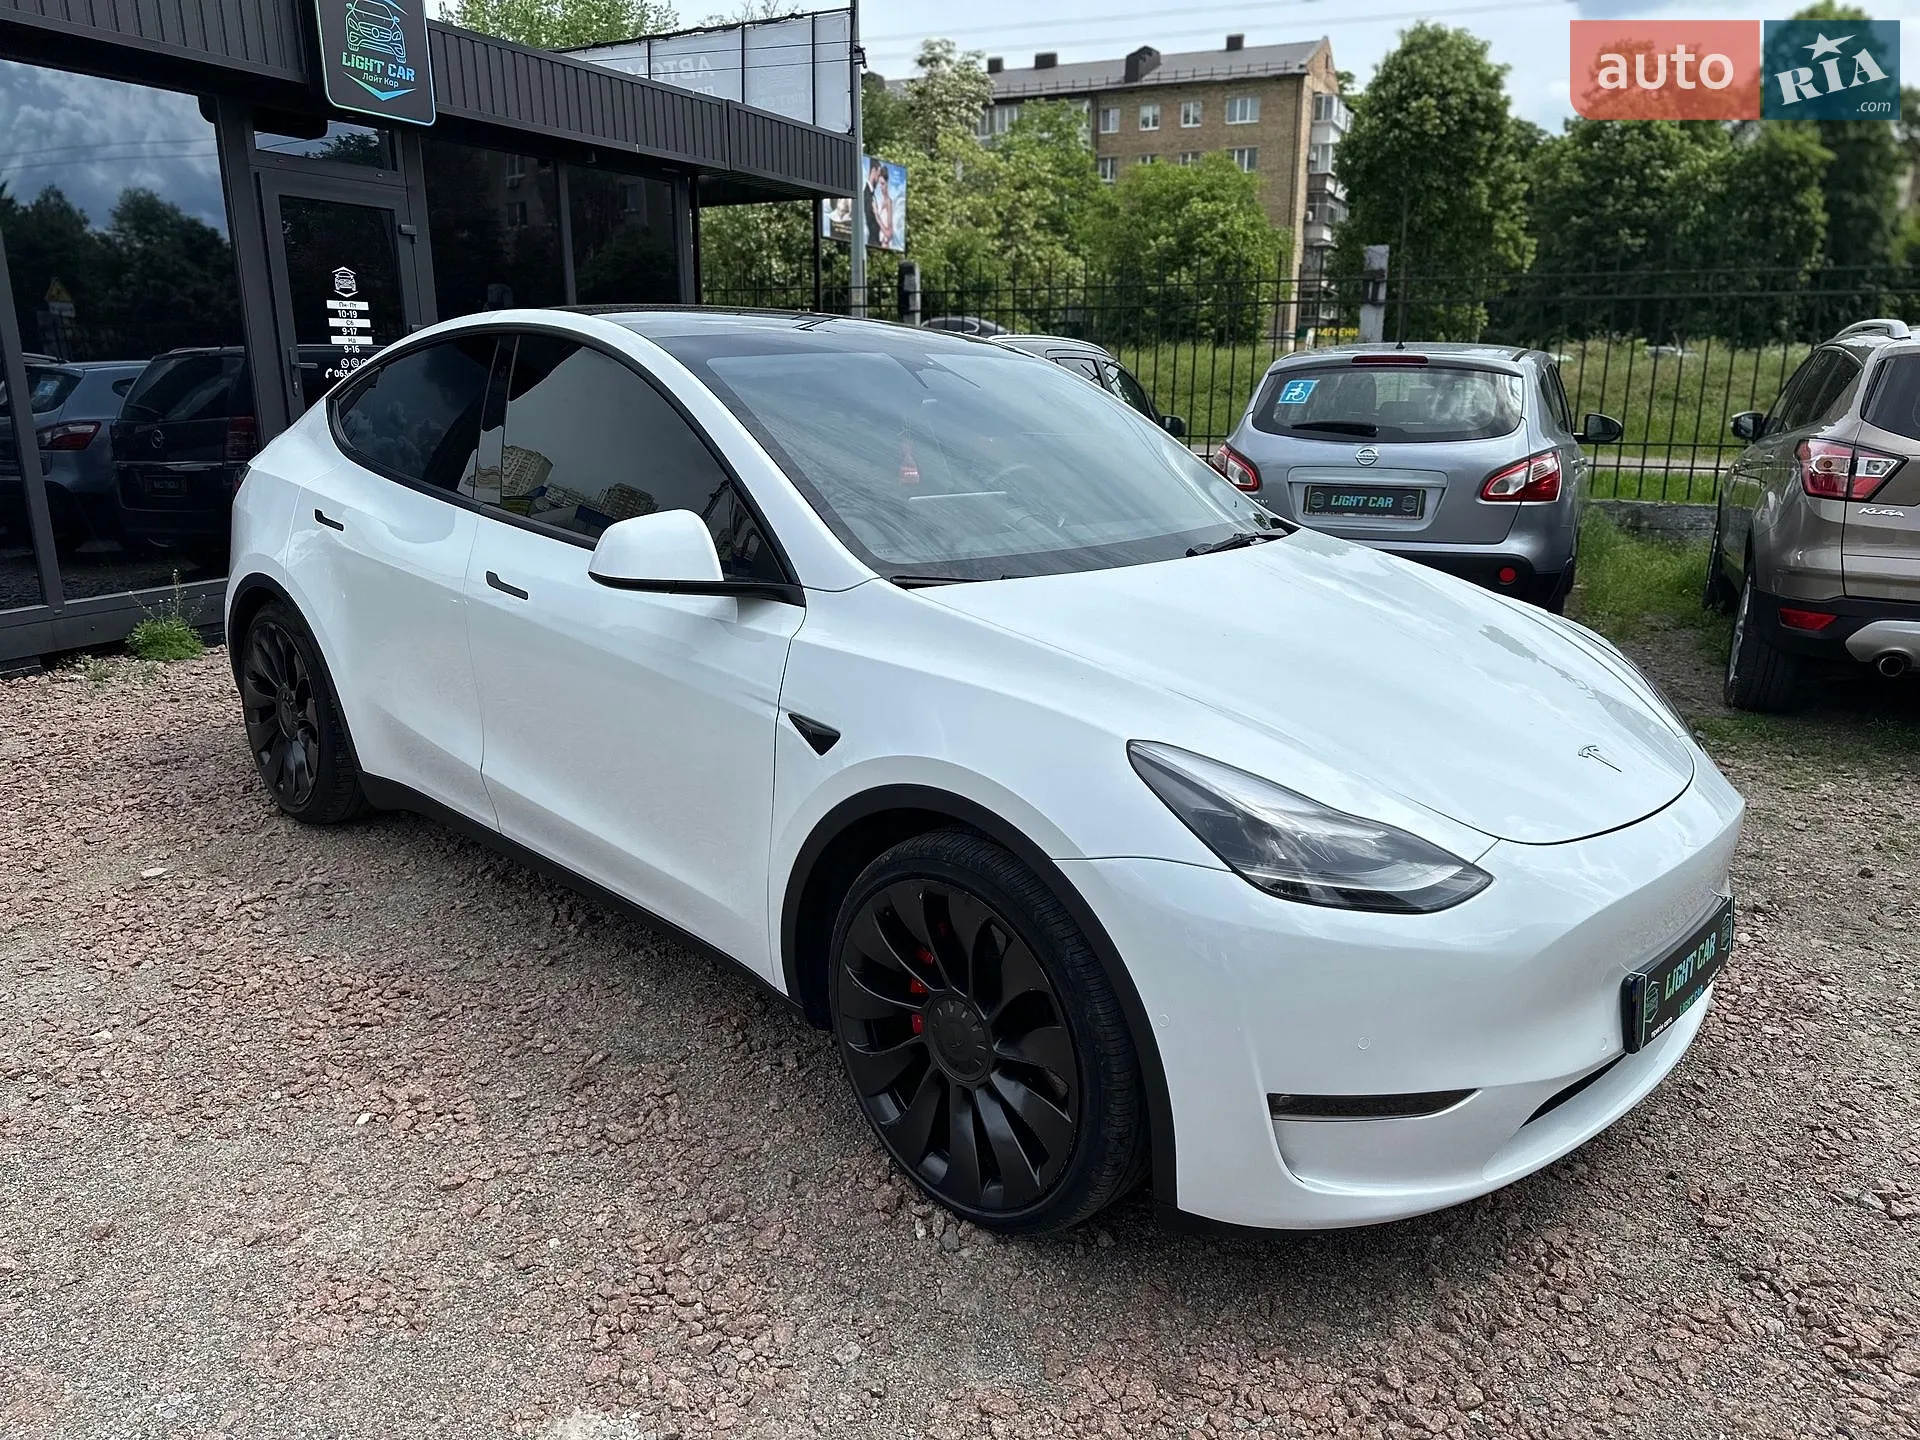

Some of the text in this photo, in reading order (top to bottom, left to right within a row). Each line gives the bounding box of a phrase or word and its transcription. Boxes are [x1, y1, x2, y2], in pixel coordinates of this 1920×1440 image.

[341, 51, 415, 82] LIGHT CAR
[362, 72, 399, 88] Лайт Кар
[338, 310, 357, 318] 10-19
[341, 327, 358, 335] 9-17
[344, 345, 360, 353] 9-16
[1330, 495, 1393, 508] LIGHT CAR
[1665, 951, 1697, 1001] LIGHT
[1697, 931, 1716, 970] CAR
